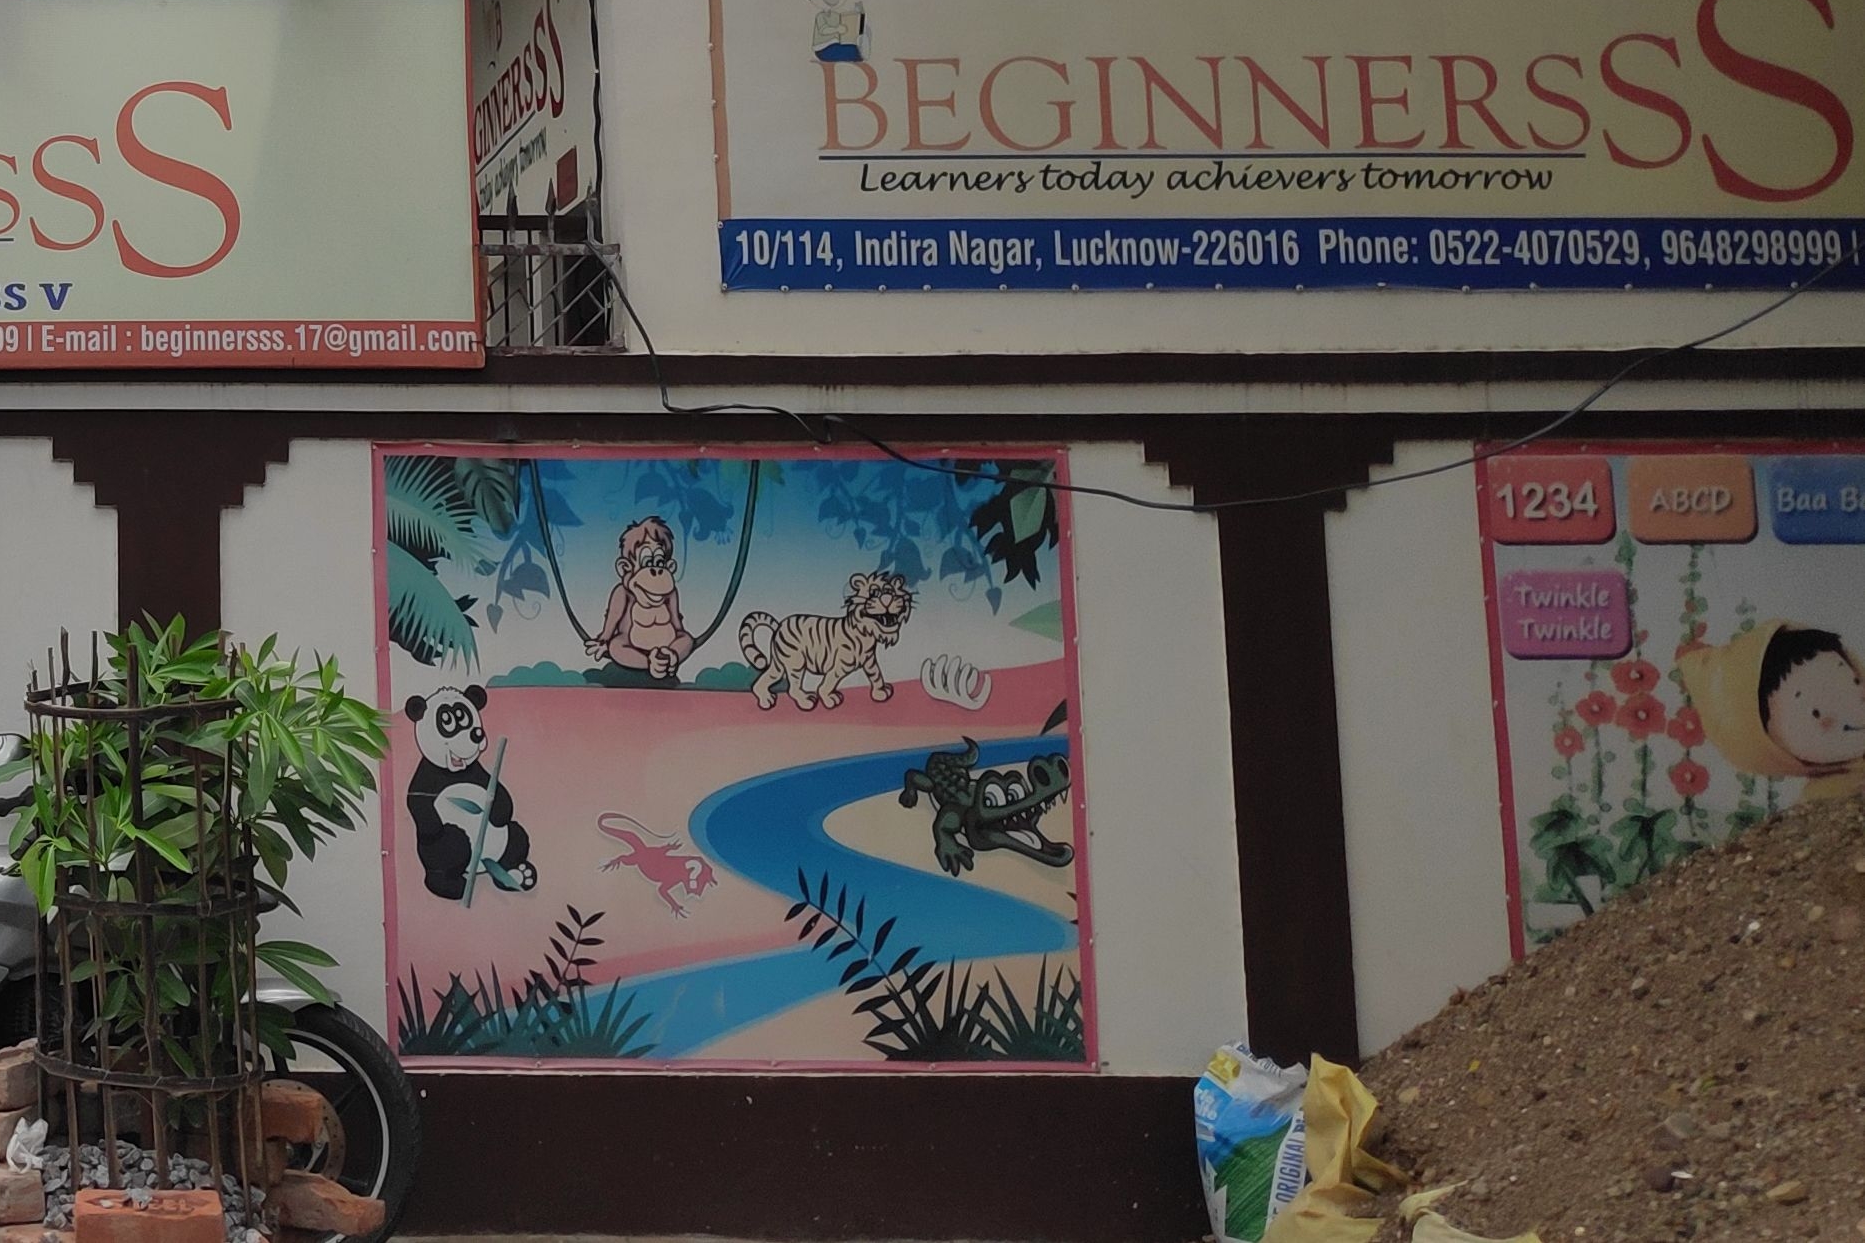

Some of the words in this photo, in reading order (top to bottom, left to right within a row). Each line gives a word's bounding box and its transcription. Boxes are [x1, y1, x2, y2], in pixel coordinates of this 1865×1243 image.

[860, 163, 1034, 193] Learners
[1040, 162, 1154, 199] today
[1166, 161, 1356, 191] achievers
[1360, 163, 1552, 189] tomorrow
[735, 231, 843, 272] 10/114,
[855, 231, 938, 266] Indira
[949, 231, 1042, 274] Nagar,
[1054, 229, 1299, 266] Lucknow-226016
[1318, 229, 1419, 264] Phone:
[1429, 230, 1650, 271] 0522-4070529,
[1662, 230, 1841, 265] 9648298999
[39, 283, 72, 310] V
[42, 325, 116, 352] E-mail
[141, 324, 477, 357] beginnersss.17@gmail.com
[1496, 482, 1598, 520] 1234
[1650, 487, 1732, 512] ABCD
[1777, 487, 1827, 511] Baa
[1514, 583, 1609, 607] Twinkle
[1519, 618, 1612, 641] Twinkle
